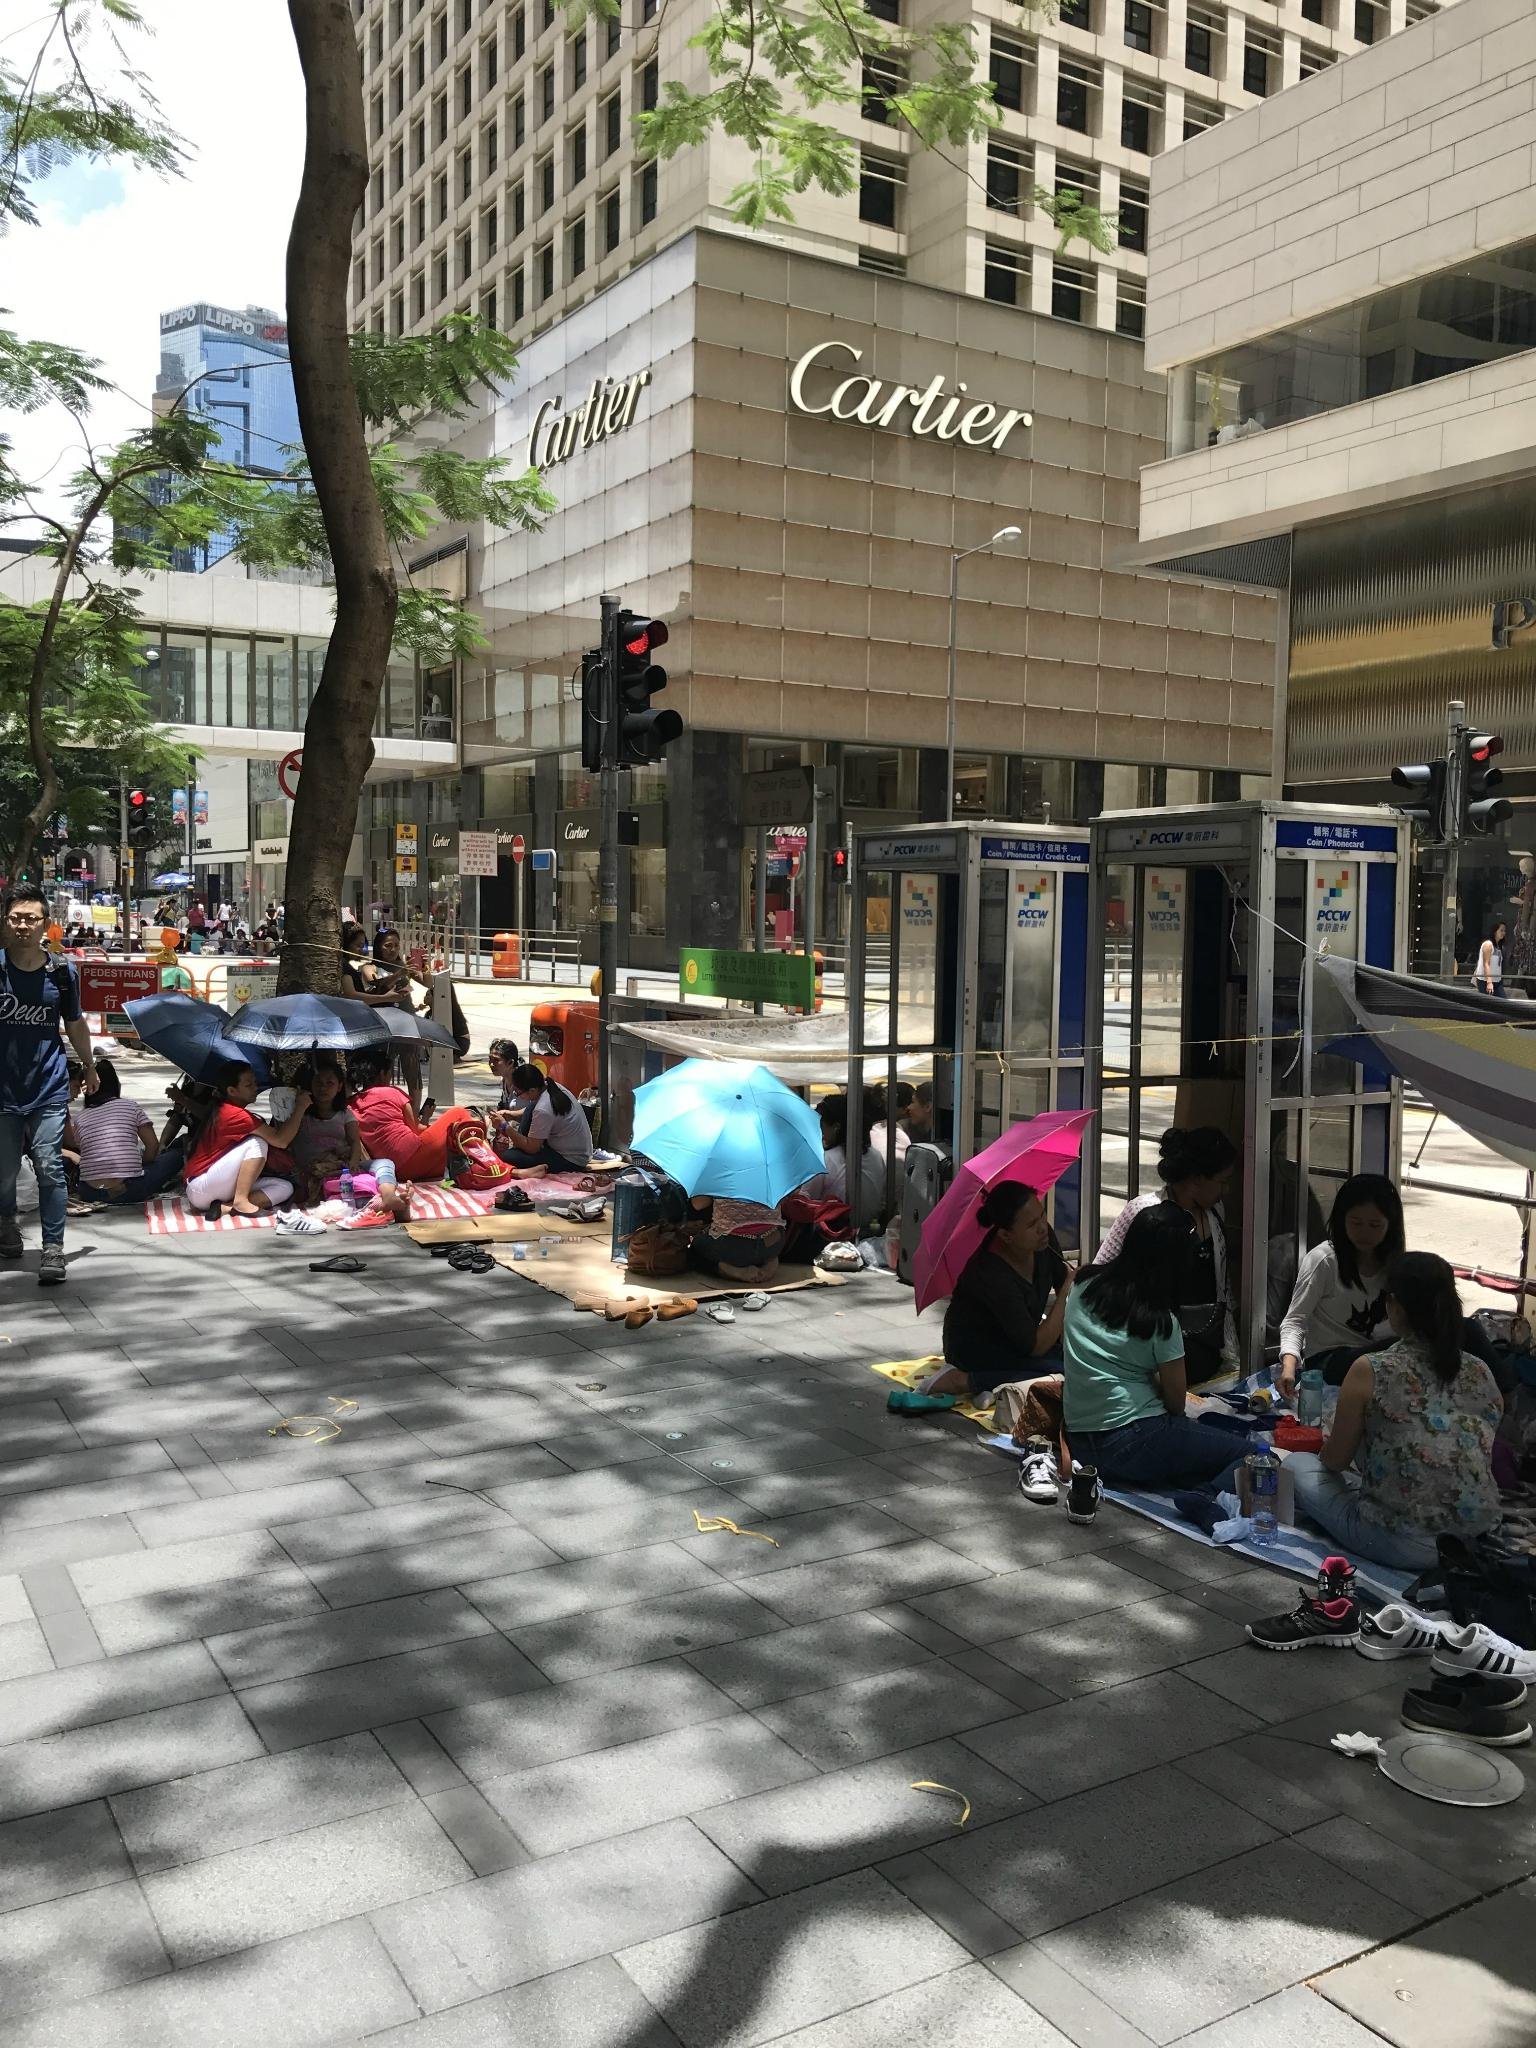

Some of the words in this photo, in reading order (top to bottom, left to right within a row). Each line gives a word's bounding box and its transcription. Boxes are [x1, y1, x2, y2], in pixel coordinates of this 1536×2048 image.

[162, 306, 196, 330] LIPPO
[206, 307, 255, 336] LIPPO
[791, 341, 1032, 449] Cartier
[528, 370, 652, 472] Cartier
[565, 823, 590, 840] Cartier
[1150, 831, 1184, 844] PCCW
[432, 833, 451, 847] Cartier
[893, 844, 917, 856] PCCW
[1018, 909, 1049, 919] PCCW
[1316, 909, 1351, 921] PCCW
[83, 967, 156, 979] PEDESTRIANS
[0, 993, 52, 1025] Deus
